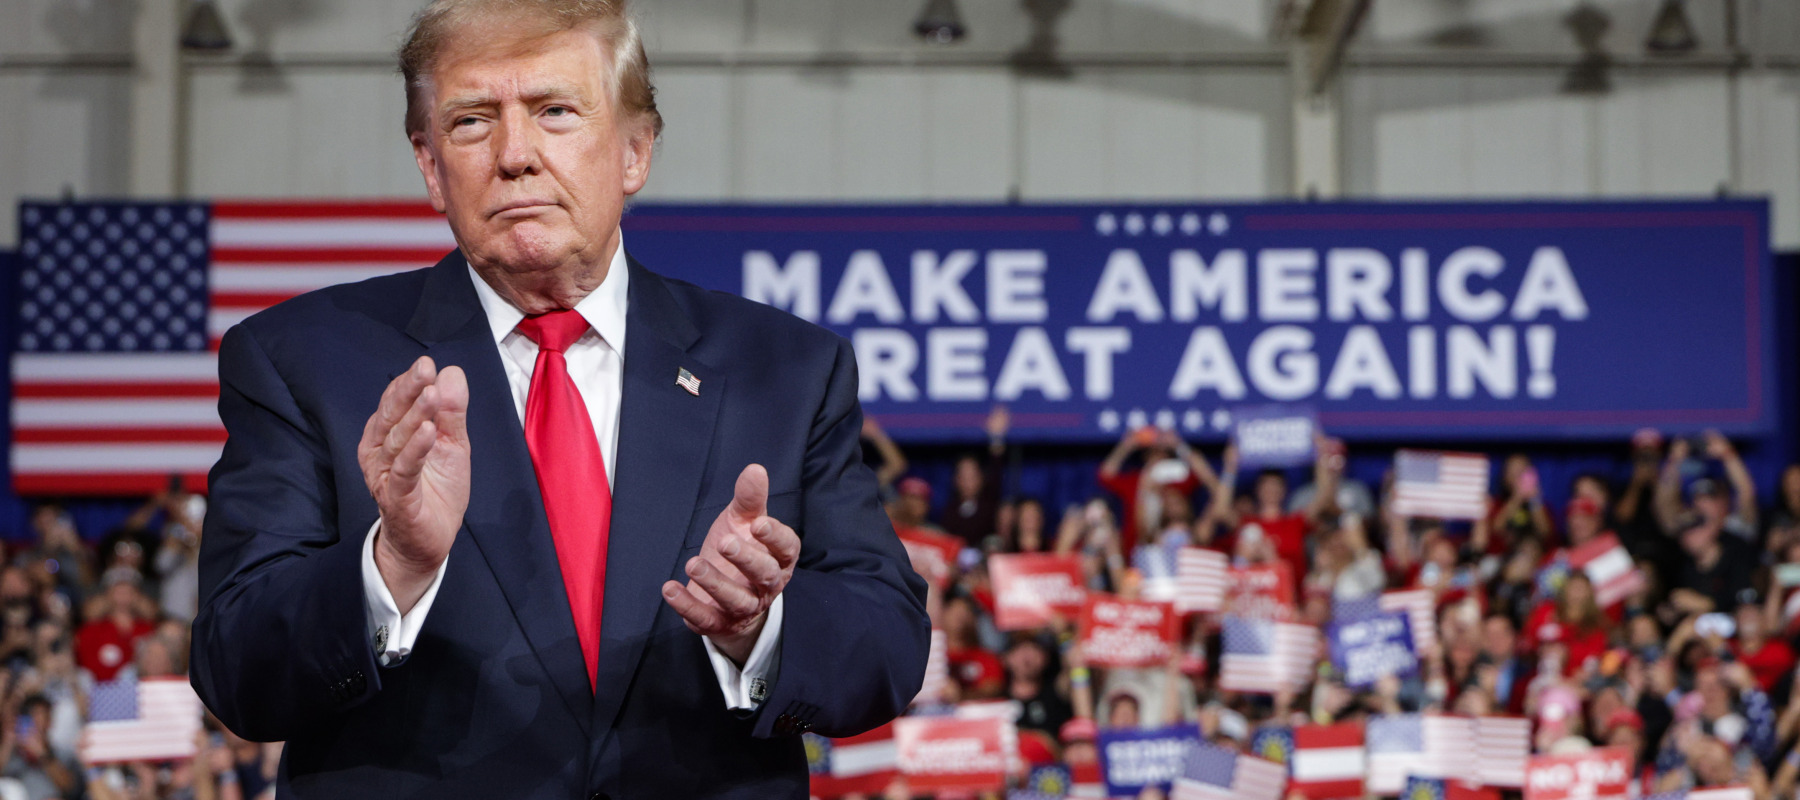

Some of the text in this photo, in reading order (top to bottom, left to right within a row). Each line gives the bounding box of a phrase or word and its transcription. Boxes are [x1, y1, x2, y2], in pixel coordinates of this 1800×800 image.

[743, 247, 1588, 323] MAKE AMERICA
[852, 326, 1556, 400] REAT AGAIN!
